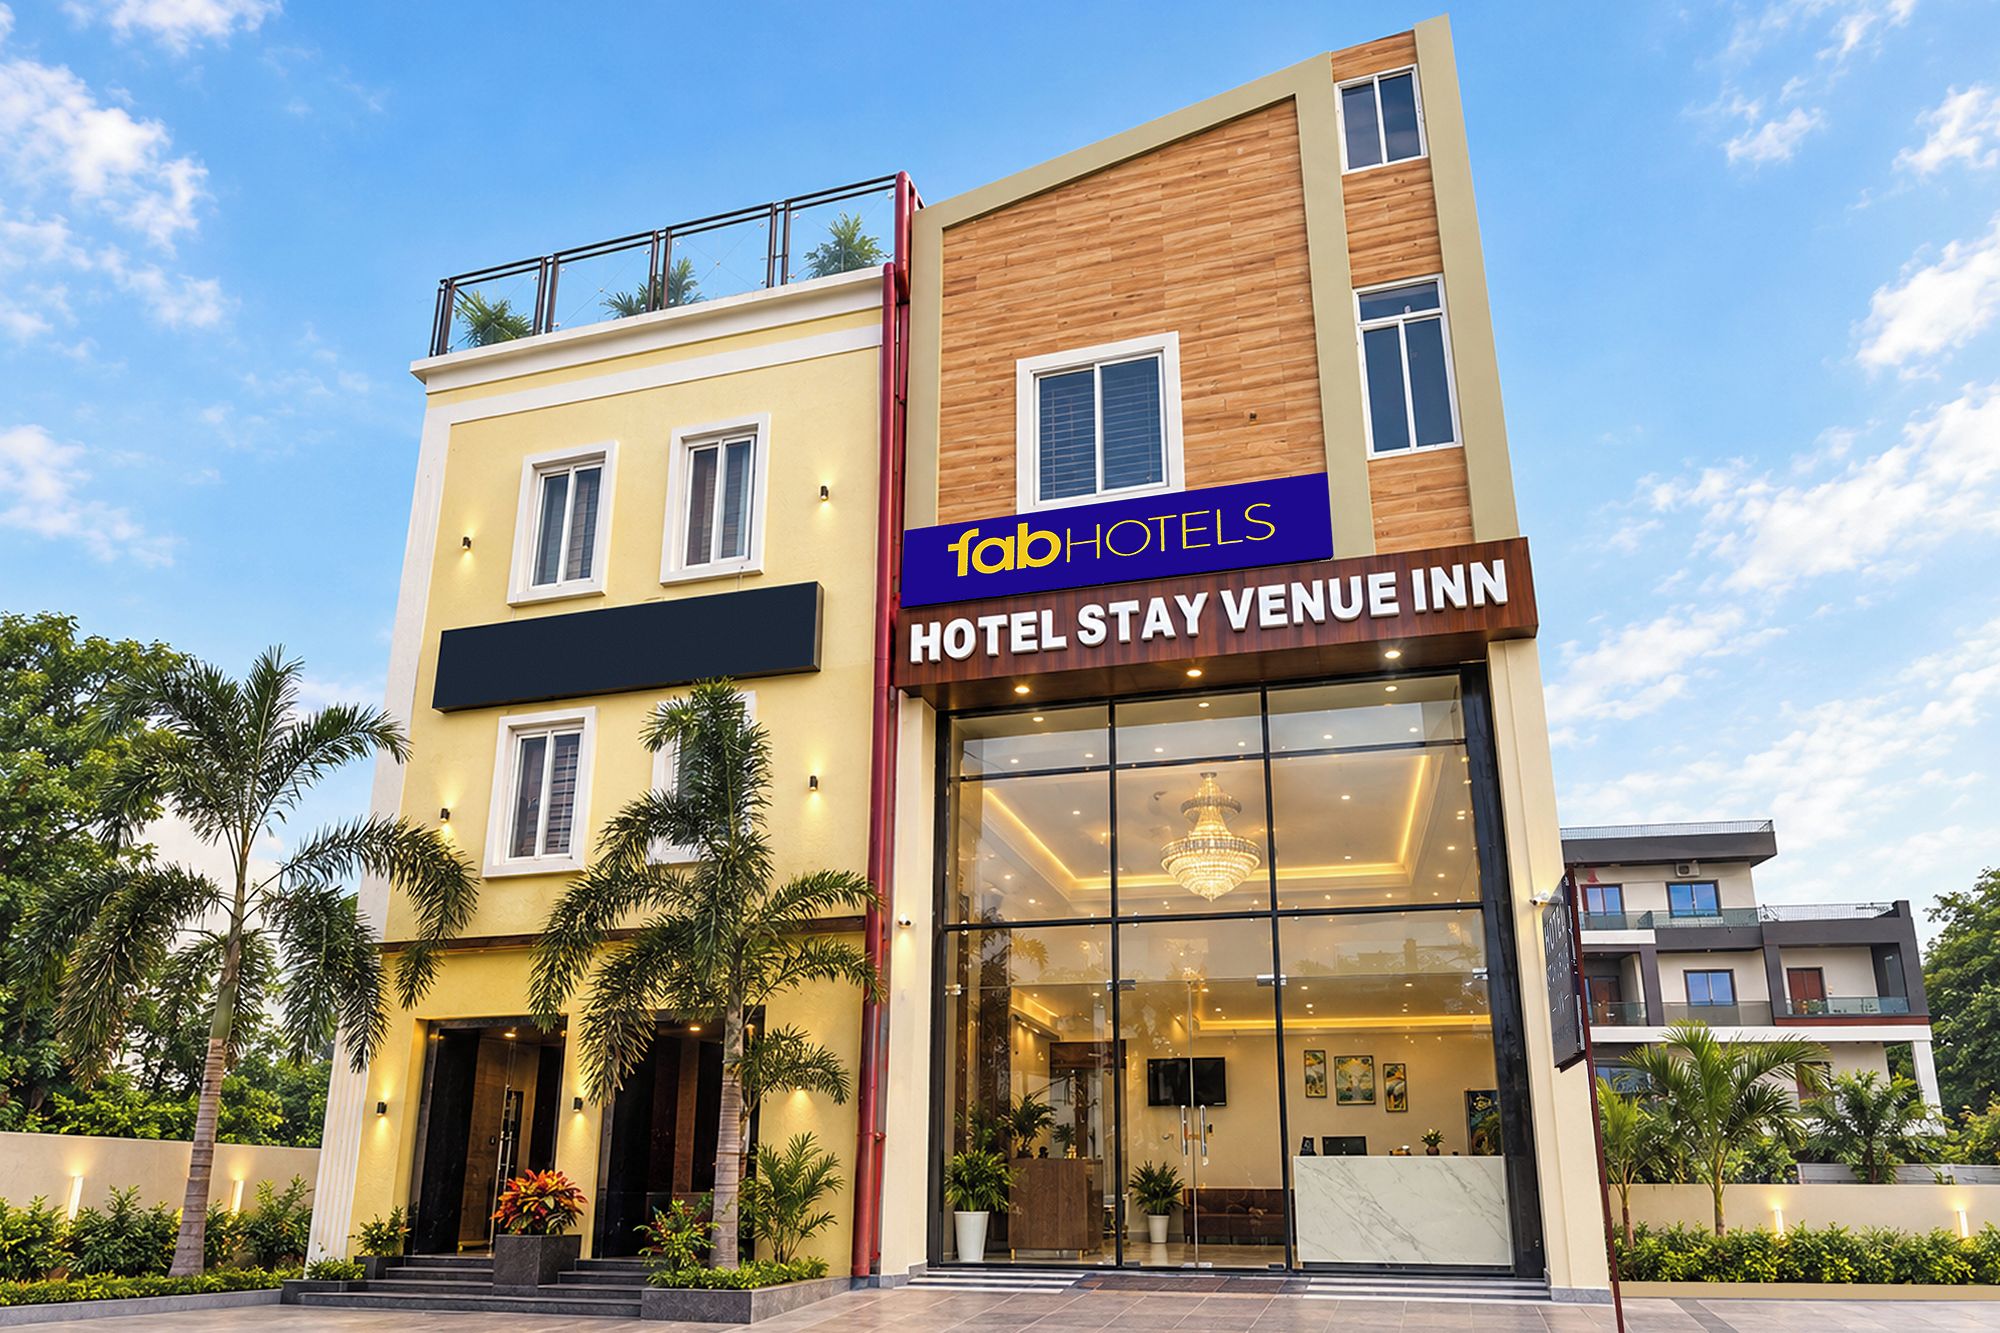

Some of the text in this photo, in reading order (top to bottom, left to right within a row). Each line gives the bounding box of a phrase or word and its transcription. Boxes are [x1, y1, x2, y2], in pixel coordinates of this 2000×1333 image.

[910, 559, 1509, 664] HOTEL STAY VENUE INN
[1544, 902, 1567, 955] HOTEL
